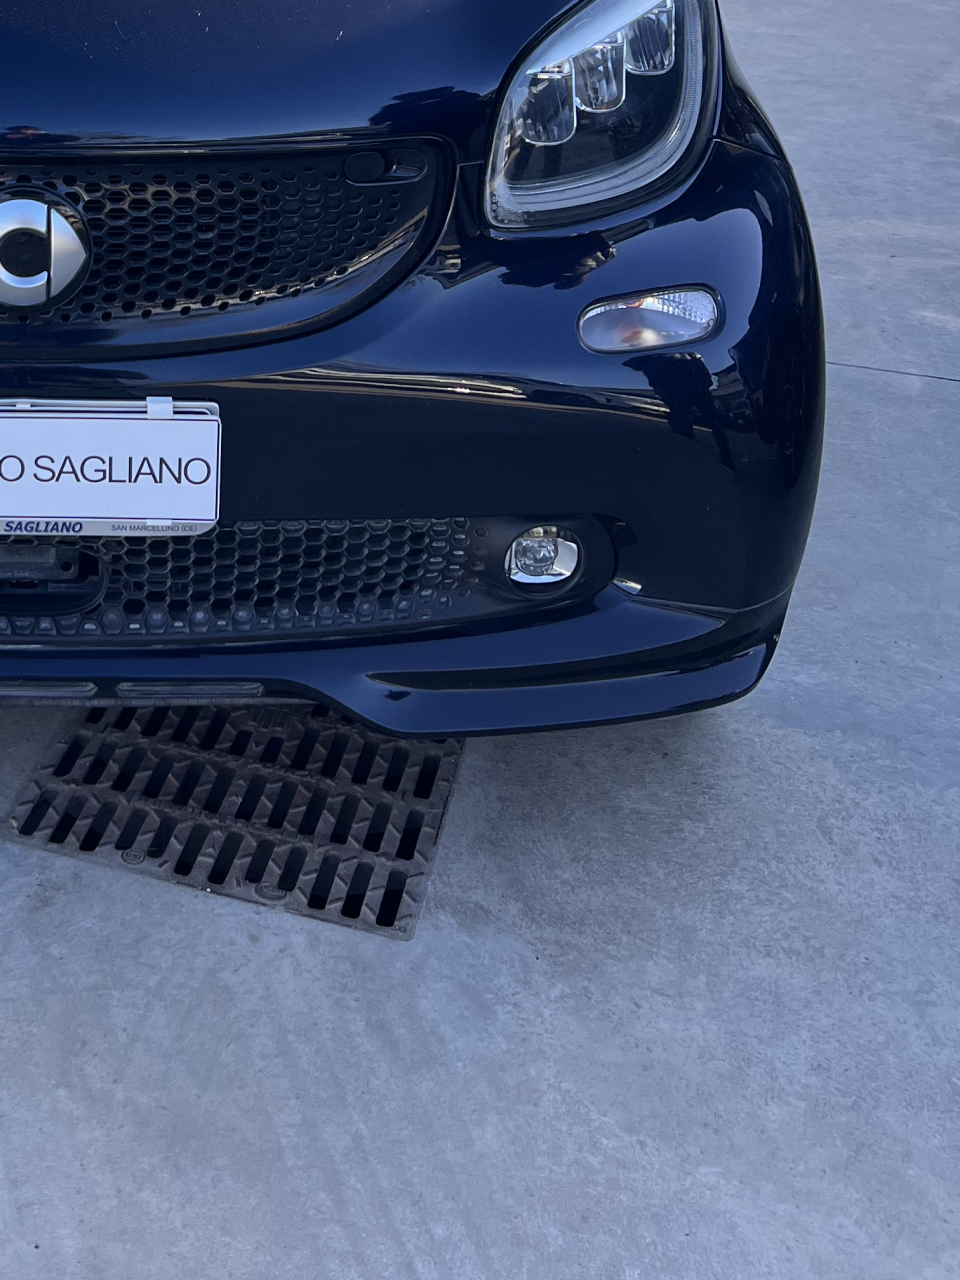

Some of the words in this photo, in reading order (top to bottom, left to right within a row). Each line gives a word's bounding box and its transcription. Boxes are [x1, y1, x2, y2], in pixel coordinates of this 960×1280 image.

[32, 454, 212, 485] SAGLIANO
[3, 521, 83, 534] SAGLIANO
[111, 524, 127, 532] SAN
[129, 524, 179, 533] MARCELLINO
[181, 524, 198, 533] (CE)
